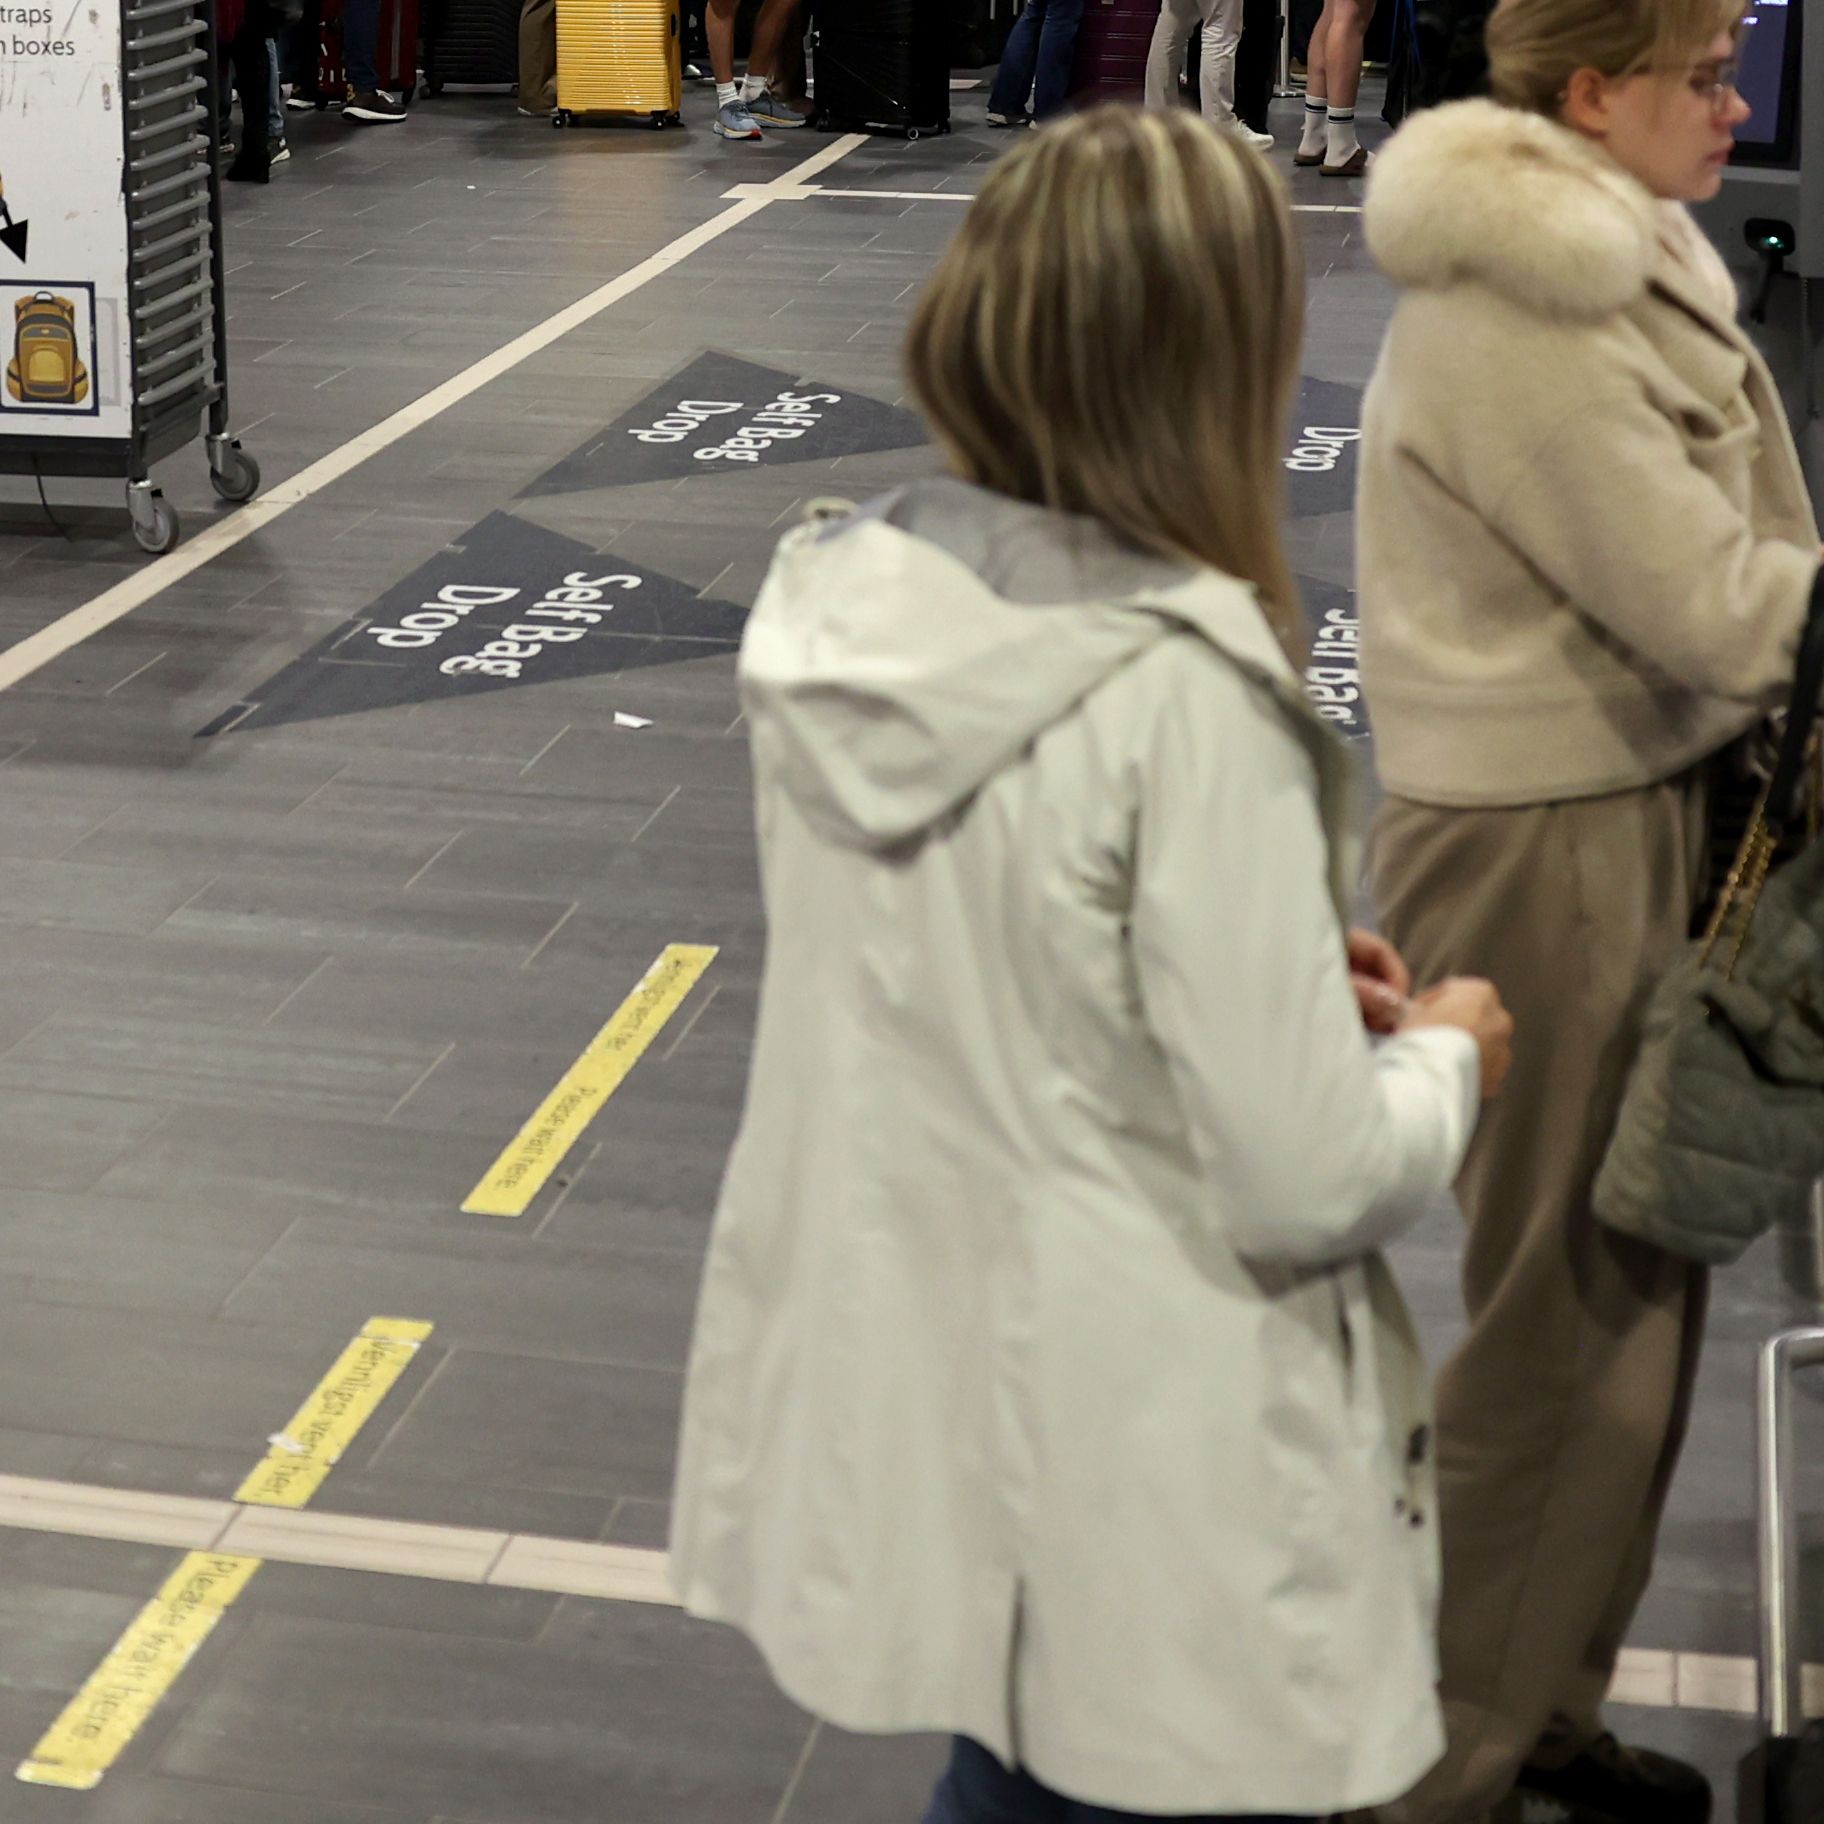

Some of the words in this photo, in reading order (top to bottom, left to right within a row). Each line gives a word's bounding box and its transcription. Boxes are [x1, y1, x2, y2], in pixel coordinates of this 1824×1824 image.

[12, 36, 75, 56] boxes
[628, 398, 743, 443] Drop
[753, 391, 842, 431] Self
[692, 426, 804, 463] Bag
[1281, 426, 1362, 472] Drop
[367, 583, 521, 649] Drop
[525, 570, 644, 626] Self
[438, 623, 588, 679] Bag
